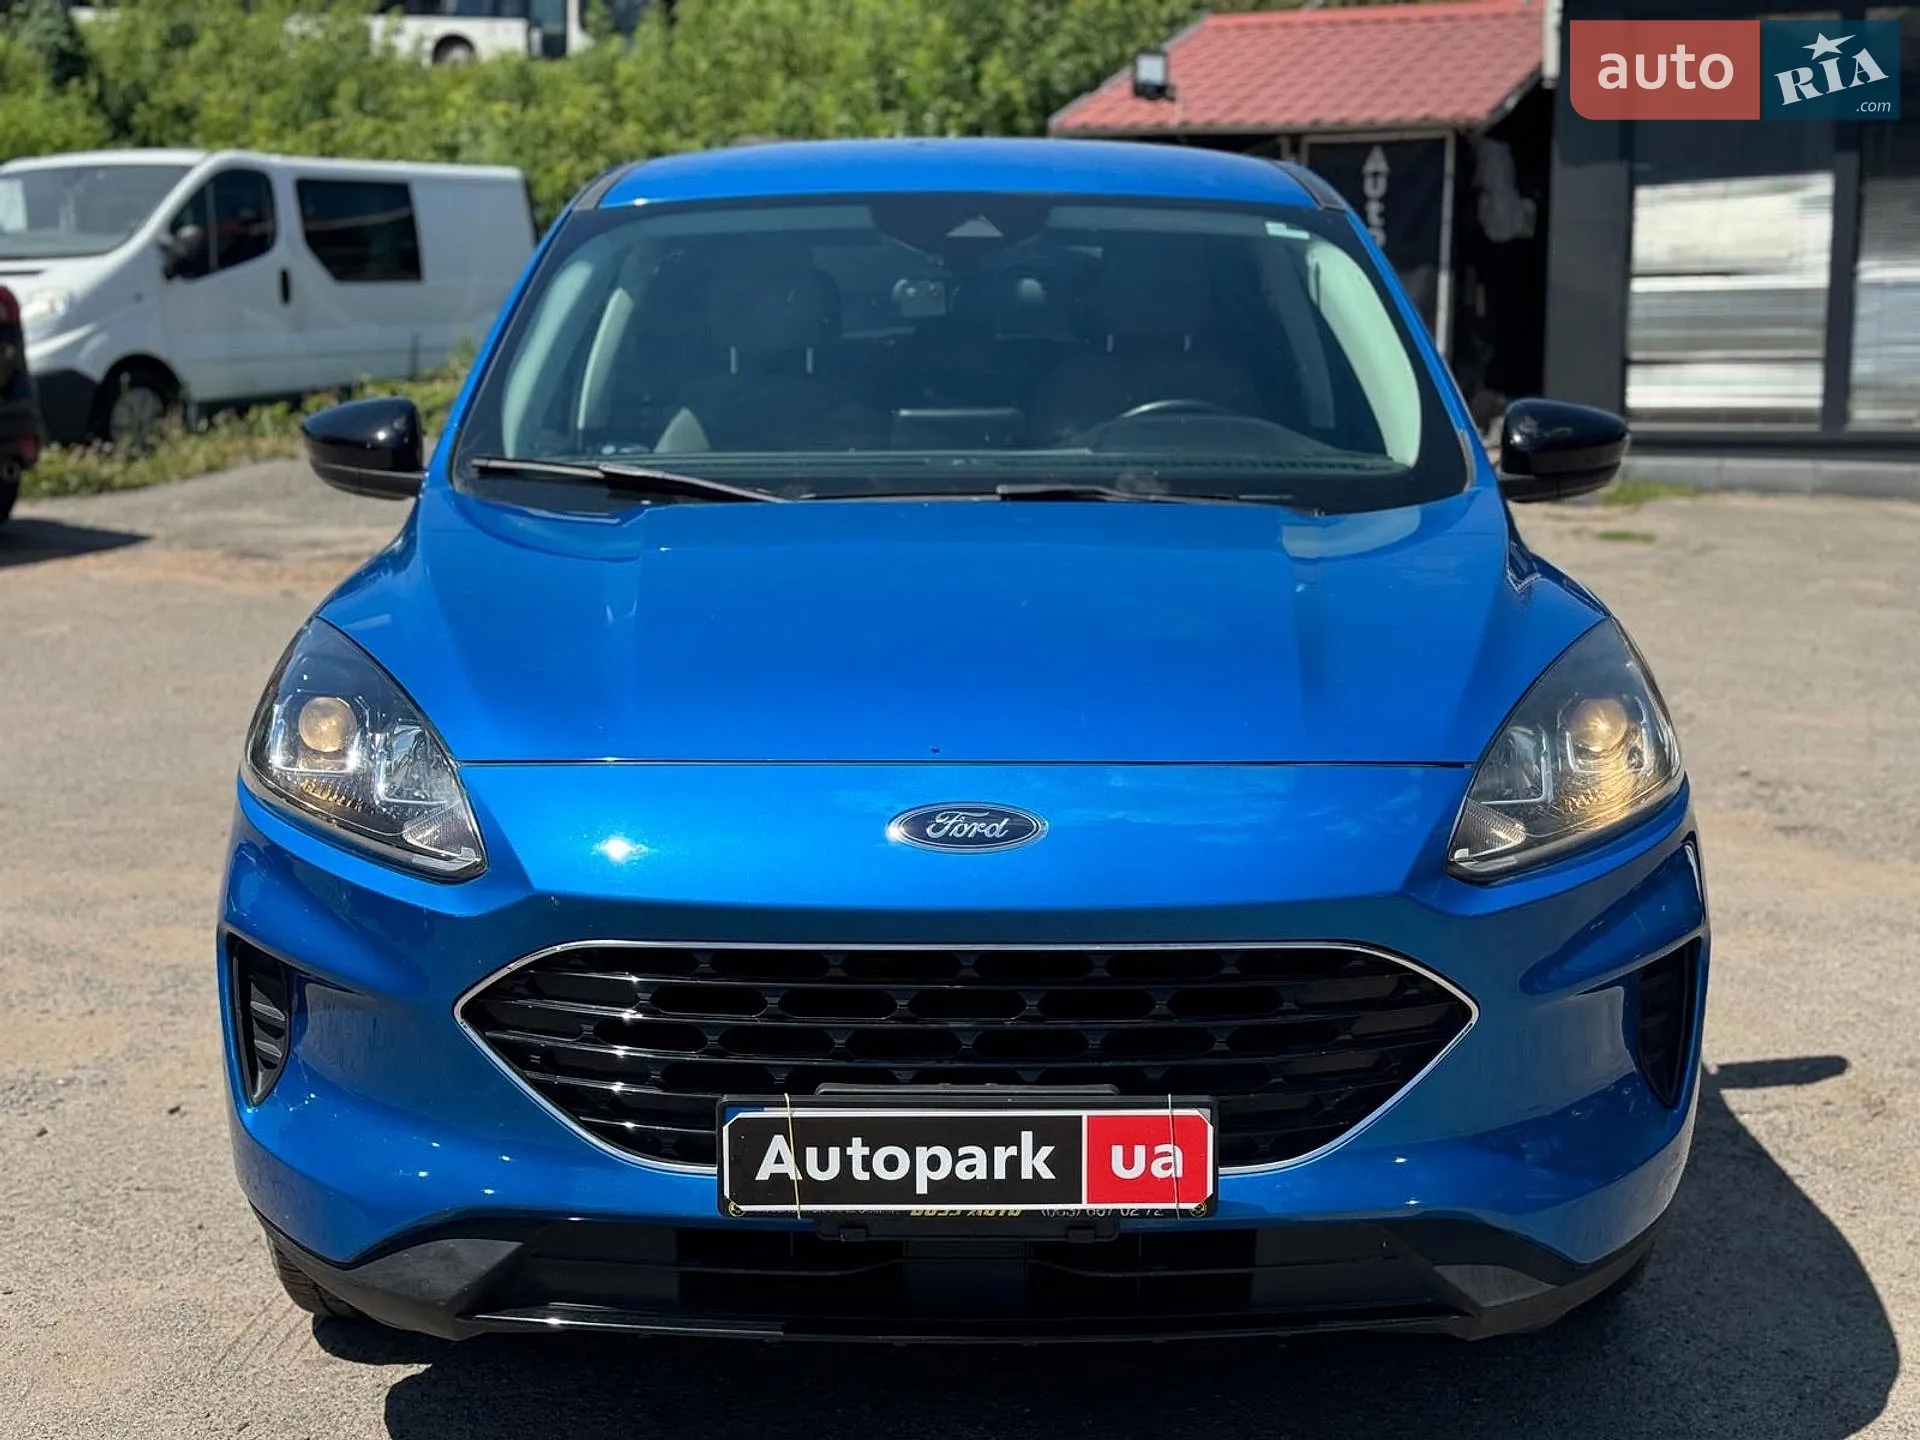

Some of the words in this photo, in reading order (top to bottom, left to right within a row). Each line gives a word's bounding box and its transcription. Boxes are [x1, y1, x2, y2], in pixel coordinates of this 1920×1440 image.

[925, 810, 1010, 839] Ford
[754, 1131, 1057, 1195] Autopark
[1110, 1141, 1184, 1181] ua
